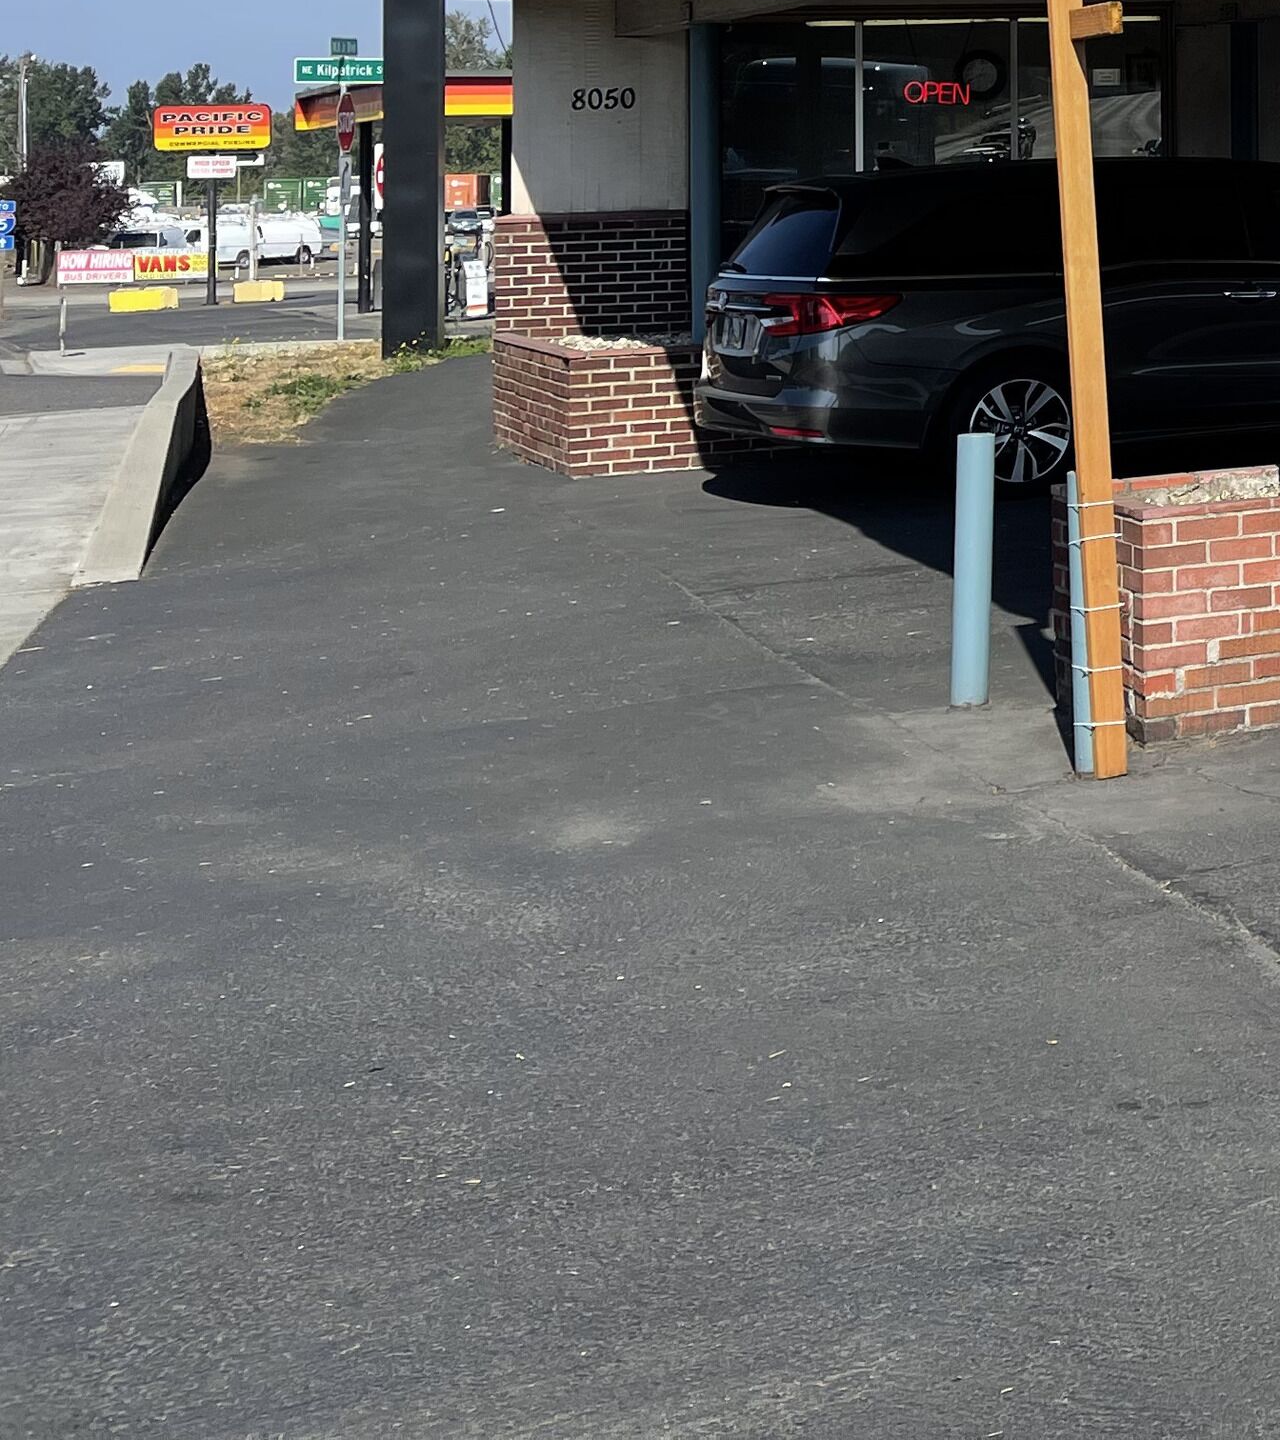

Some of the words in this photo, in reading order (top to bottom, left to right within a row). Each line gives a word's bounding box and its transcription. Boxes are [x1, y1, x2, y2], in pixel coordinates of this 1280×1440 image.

[301, 65, 313, 75] NE
[316, 63, 373, 79] Kilpatrick
[571, 87, 636, 111] 8050
[903, 80, 970, 106] OPEN
[161, 111, 262, 123] PACIFIC
[338, 111, 355, 133] STOP
[174, 124, 251, 135] PRIDE
[59, 253, 87, 269] NOW
[89, 252, 132, 268] HIRING
[138, 254, 191, 273] VANS
[63, 271, 83, 281] BUS
[86, 271, 128, 281] DRIVERS
